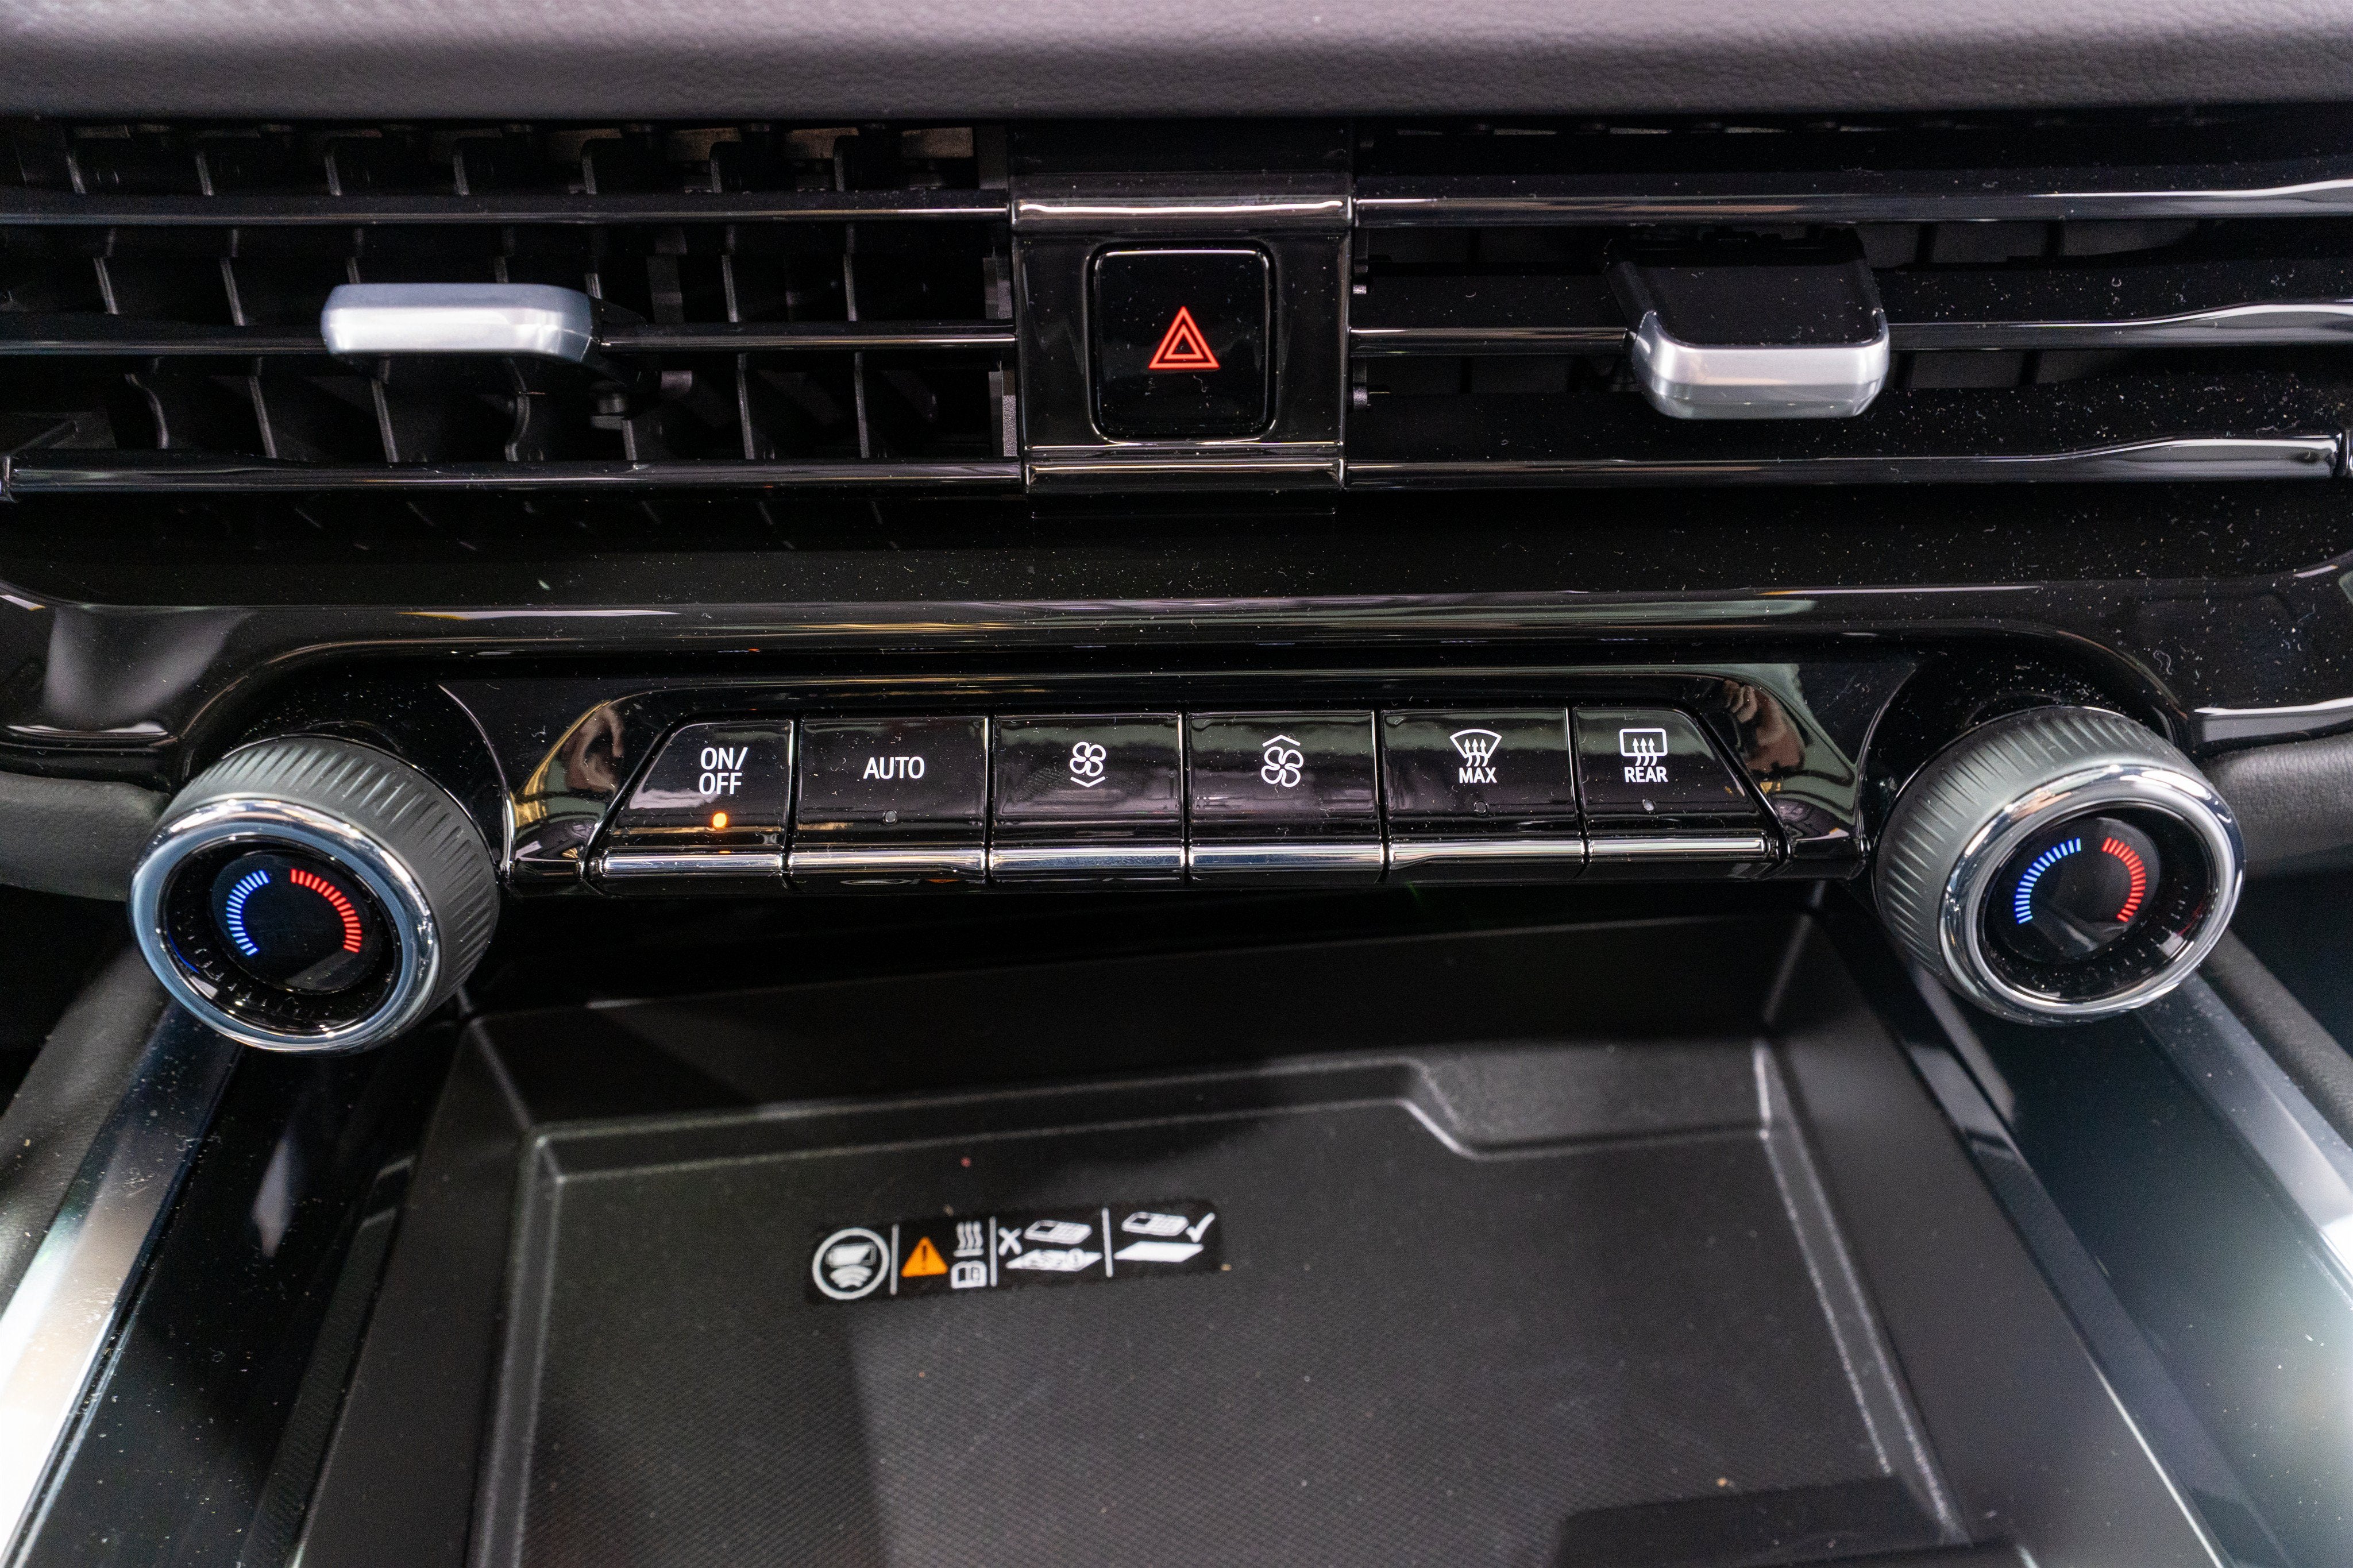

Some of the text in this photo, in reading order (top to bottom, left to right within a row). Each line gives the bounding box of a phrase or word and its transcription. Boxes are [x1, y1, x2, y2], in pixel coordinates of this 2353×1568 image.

[700, 747, 748, 770] ON/
[863, 756, 925, 779] AUTO
[699, 772, 742, 795] OFF
[1459, 767, 1498, 783] MAX
[1624, 766, 1669, 783] REAR
